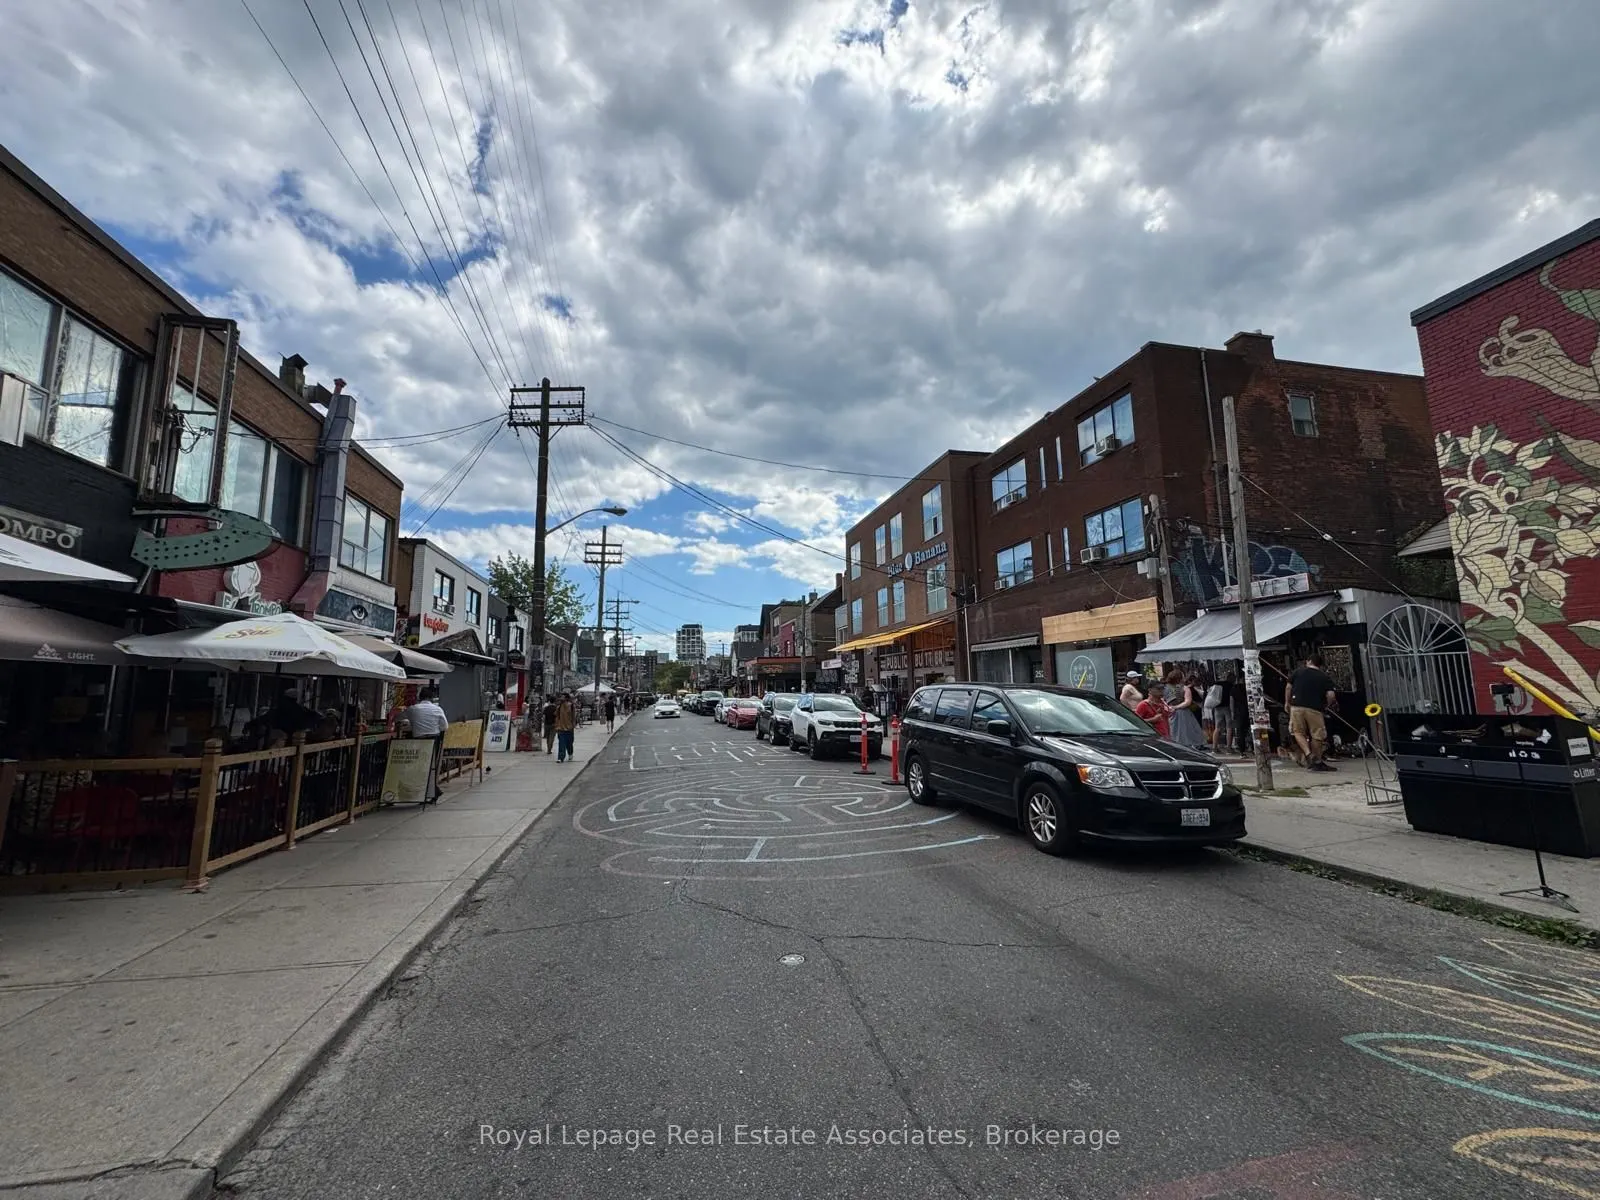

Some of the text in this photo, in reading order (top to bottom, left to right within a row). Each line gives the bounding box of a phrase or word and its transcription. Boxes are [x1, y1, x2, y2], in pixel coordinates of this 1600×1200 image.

[914, 541, 948, 565] Banana
[1225, 577, 1299, 602] SVER
[67, 652, 95, 661] LIGHT
[269, 650, 298, 658] CERVEZA
[886, 653, 908, 671] PUBLIC
[914, 650, 945, 669] BUTTER
[1580, 767, 1596, 778] Litter
